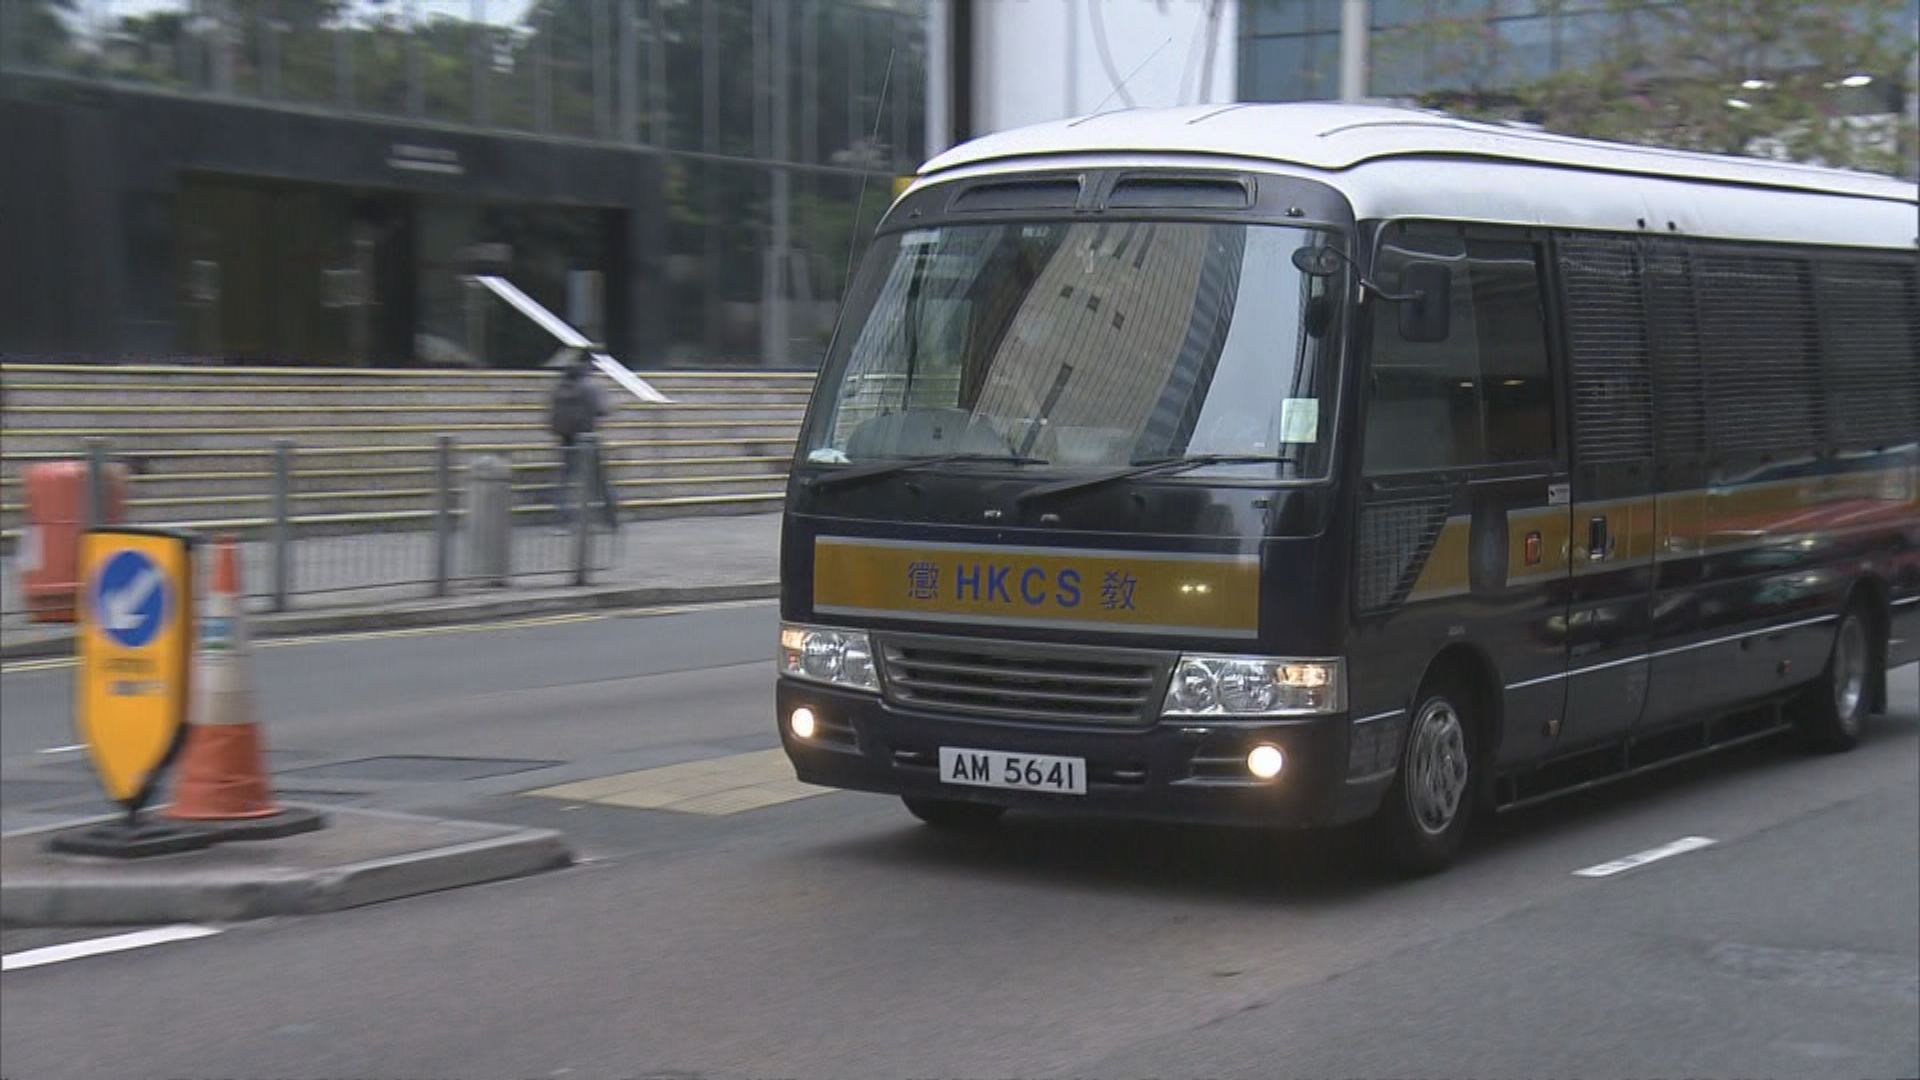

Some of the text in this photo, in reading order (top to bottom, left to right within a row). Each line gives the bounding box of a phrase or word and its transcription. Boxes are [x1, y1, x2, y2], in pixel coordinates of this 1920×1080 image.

[955, 563, 1082, 607] HKCS
[952, 753, 1074, 790] AM 5641
